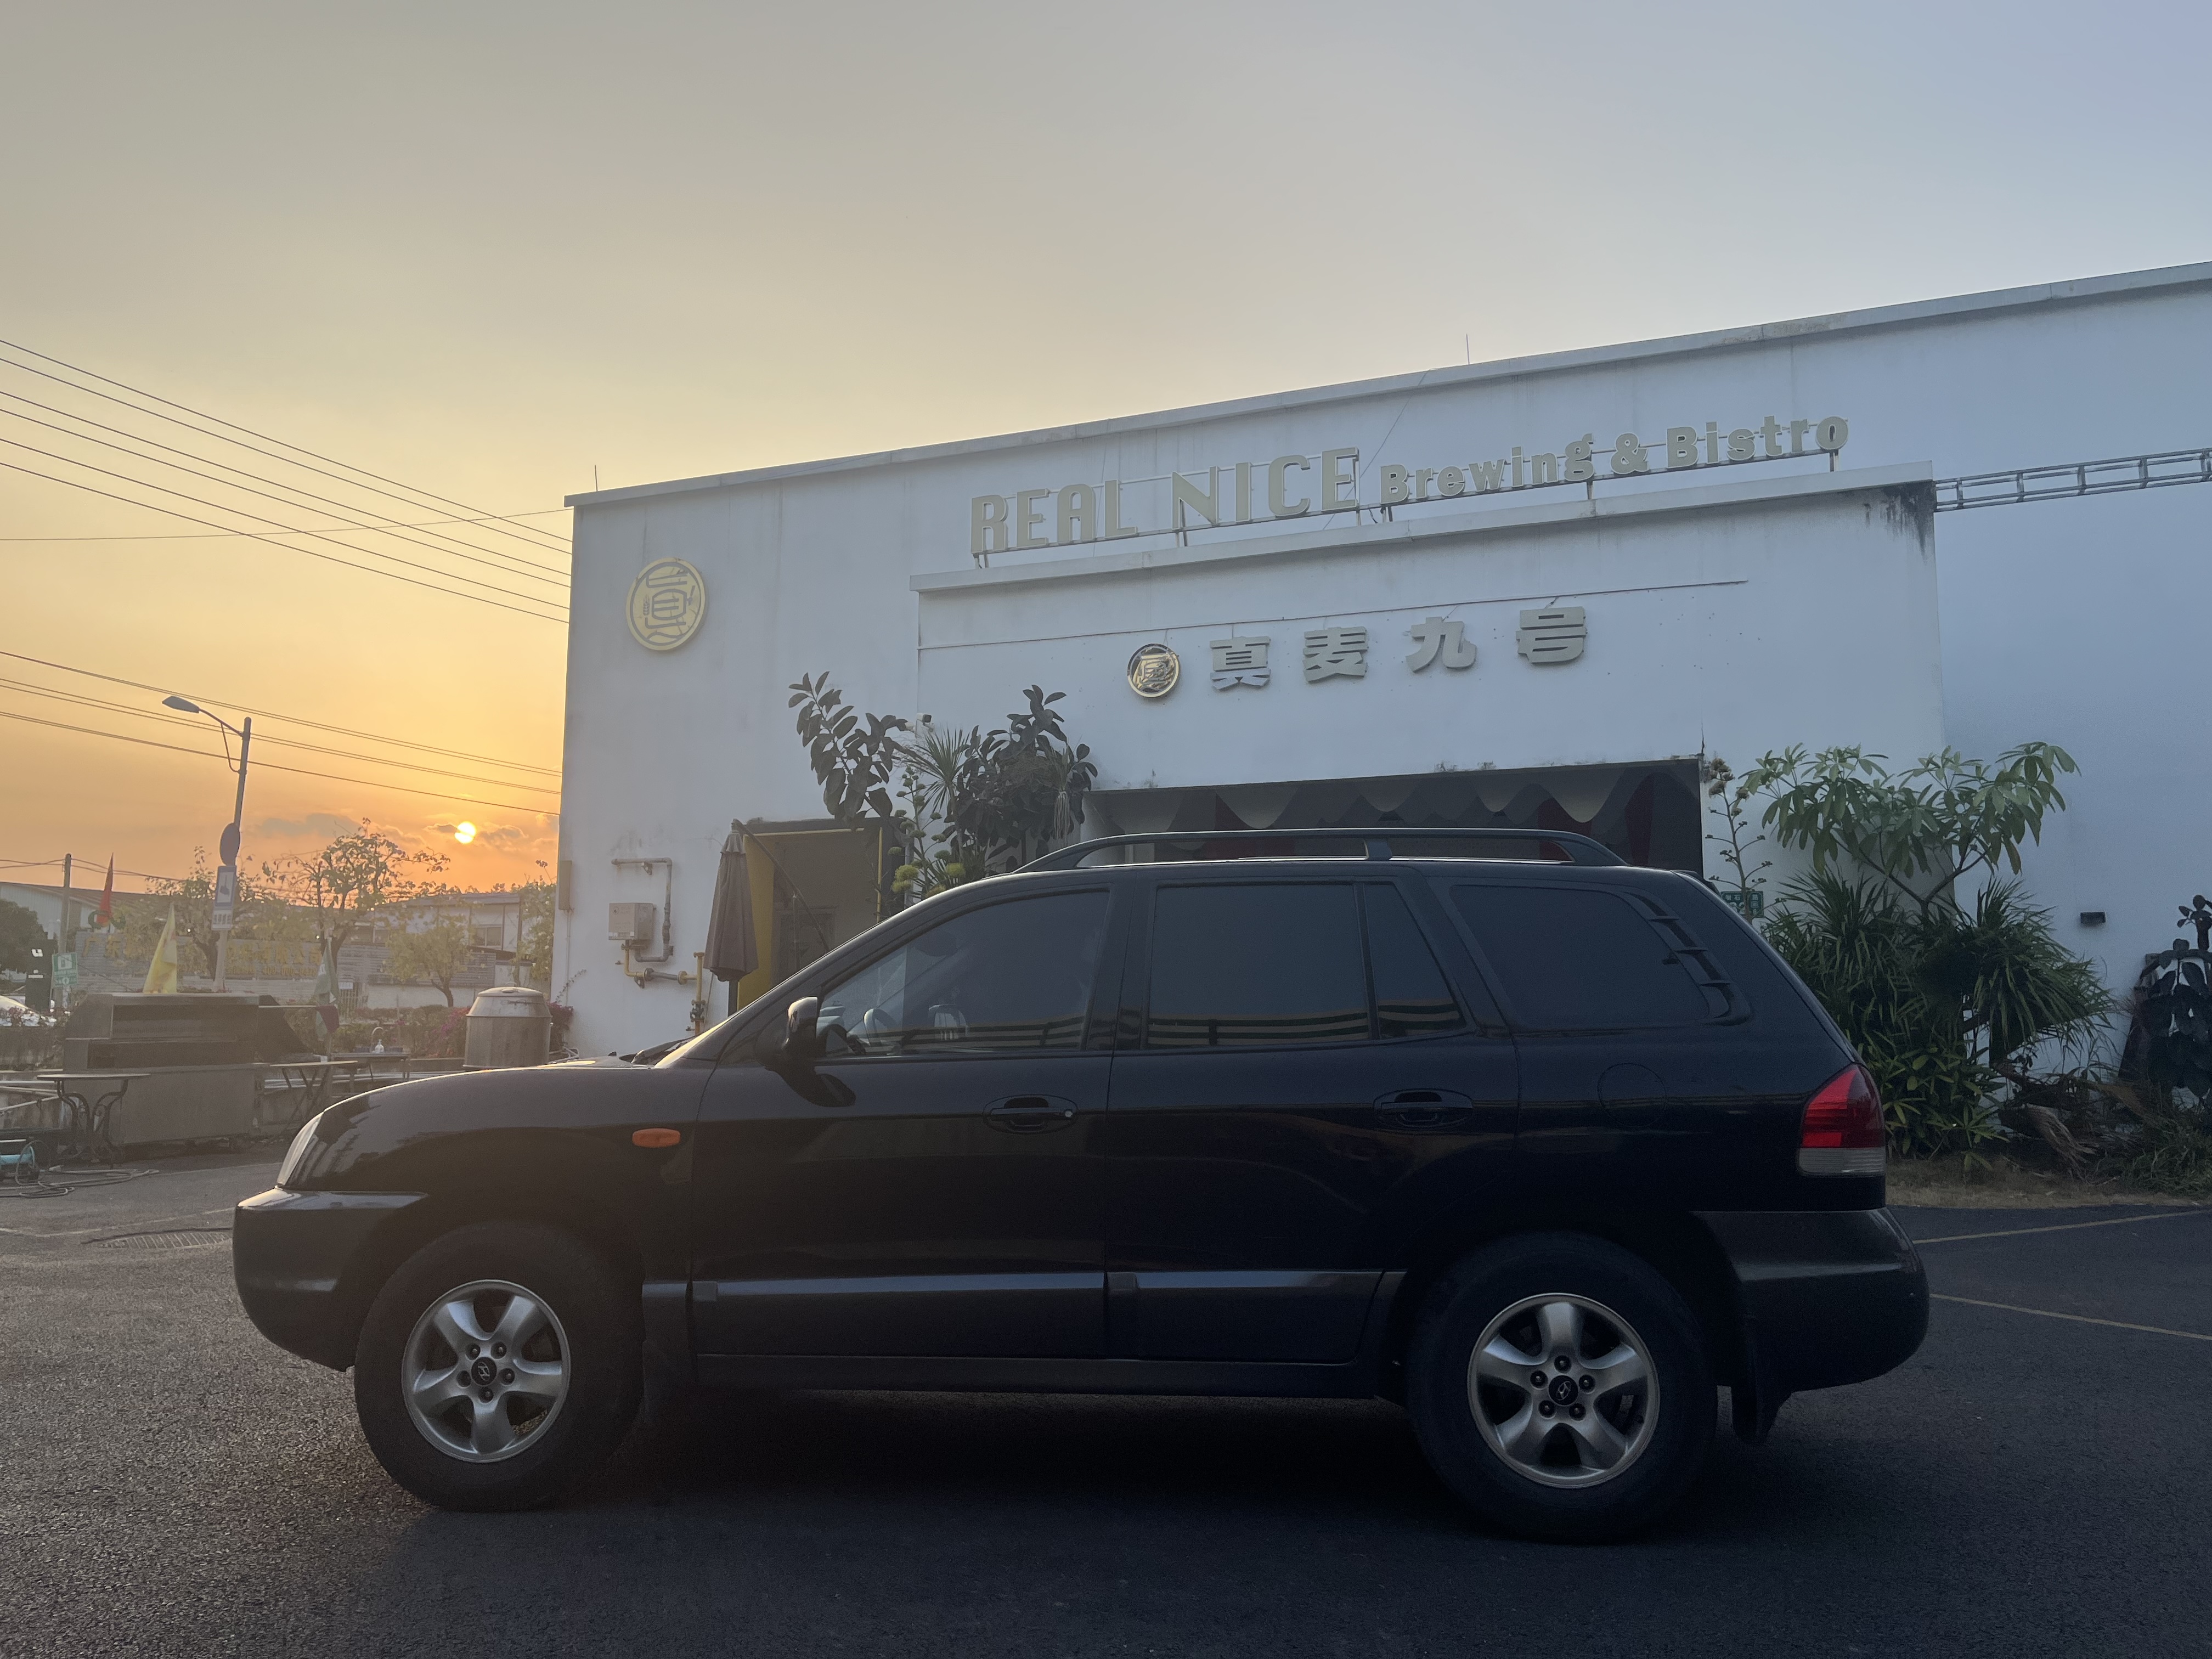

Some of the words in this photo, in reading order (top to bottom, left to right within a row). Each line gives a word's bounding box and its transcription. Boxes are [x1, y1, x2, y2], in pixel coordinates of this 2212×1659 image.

[970, 479, 1138, 554] REAL
[1171, 447, 1359, 531] NICE
[1380, 433, 1594, 505] Brewing
[1610, 432, 1649, 475] &
[1666, 415, 1849, 469] Bistro
[1209, 605, 1588, 692] 真麦九号
